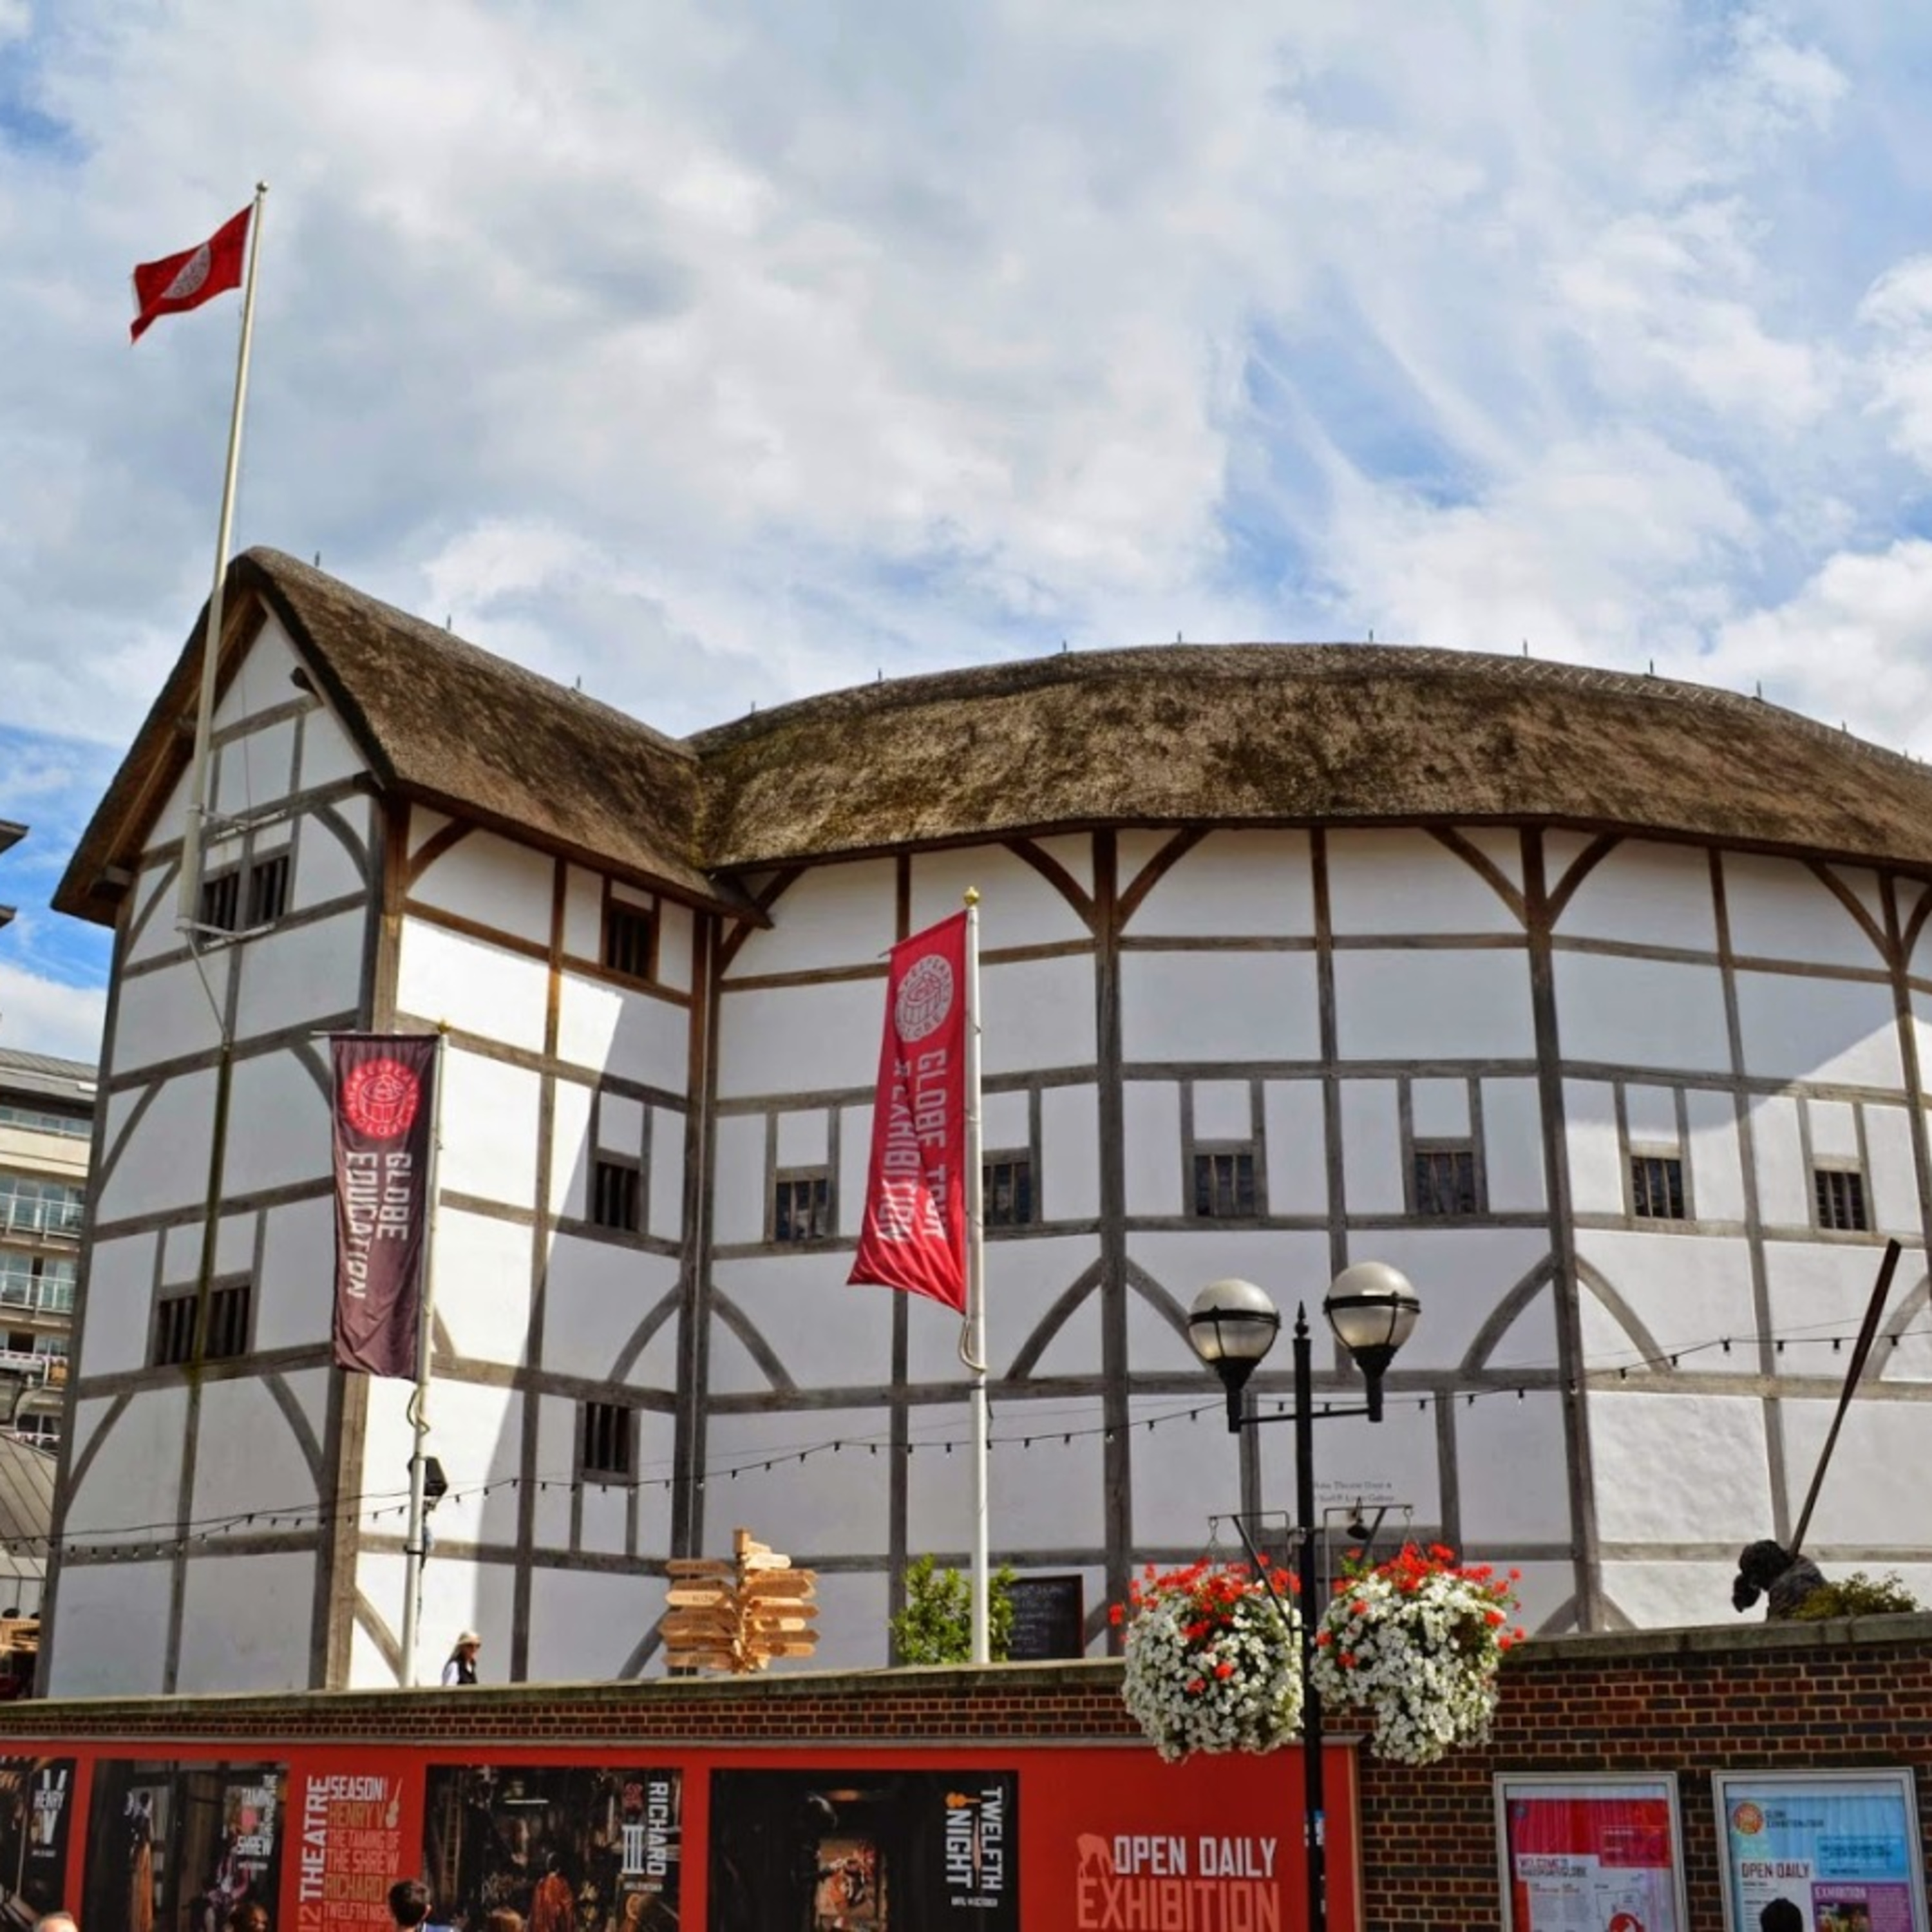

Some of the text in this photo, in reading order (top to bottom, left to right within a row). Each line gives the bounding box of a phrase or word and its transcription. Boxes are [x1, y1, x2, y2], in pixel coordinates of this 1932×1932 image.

[915, 1048, 947, 1149] GLOBE
[377, 1152, 412, 1241] GLOBE
[346, 1151, 379, 1299] EDUCATION
[329, 1776, 383, 1801] SEASON
[328, 1803, 374, 1828] HENRY
[647, 1781, 668, 1875] RICHARD
[980, 1786, 1003, 1890] TWELFTH
[300, 1776, 328, 1902] THEATRE
[327, 1828, 401, 1850] THE TAMING OF
[327, 1848, 399, 1875] THE SHREW
[621, 1824, 645, 1875] III
[945, 1808, 972, 1889] NIGHT
[1113, 1835, 1277, 1877] OPEN DAILY
[325, 1873, 383, 1902] RICHARD
[1742, 1862, 1809, 1879] OPEN DAILY
[1815, 1886, 1866, 1899] EXHIBITION
[323, 1900, 368, 1920] TWELFTH
[1077, 1877, 1280, 1932] EXHIBITION
